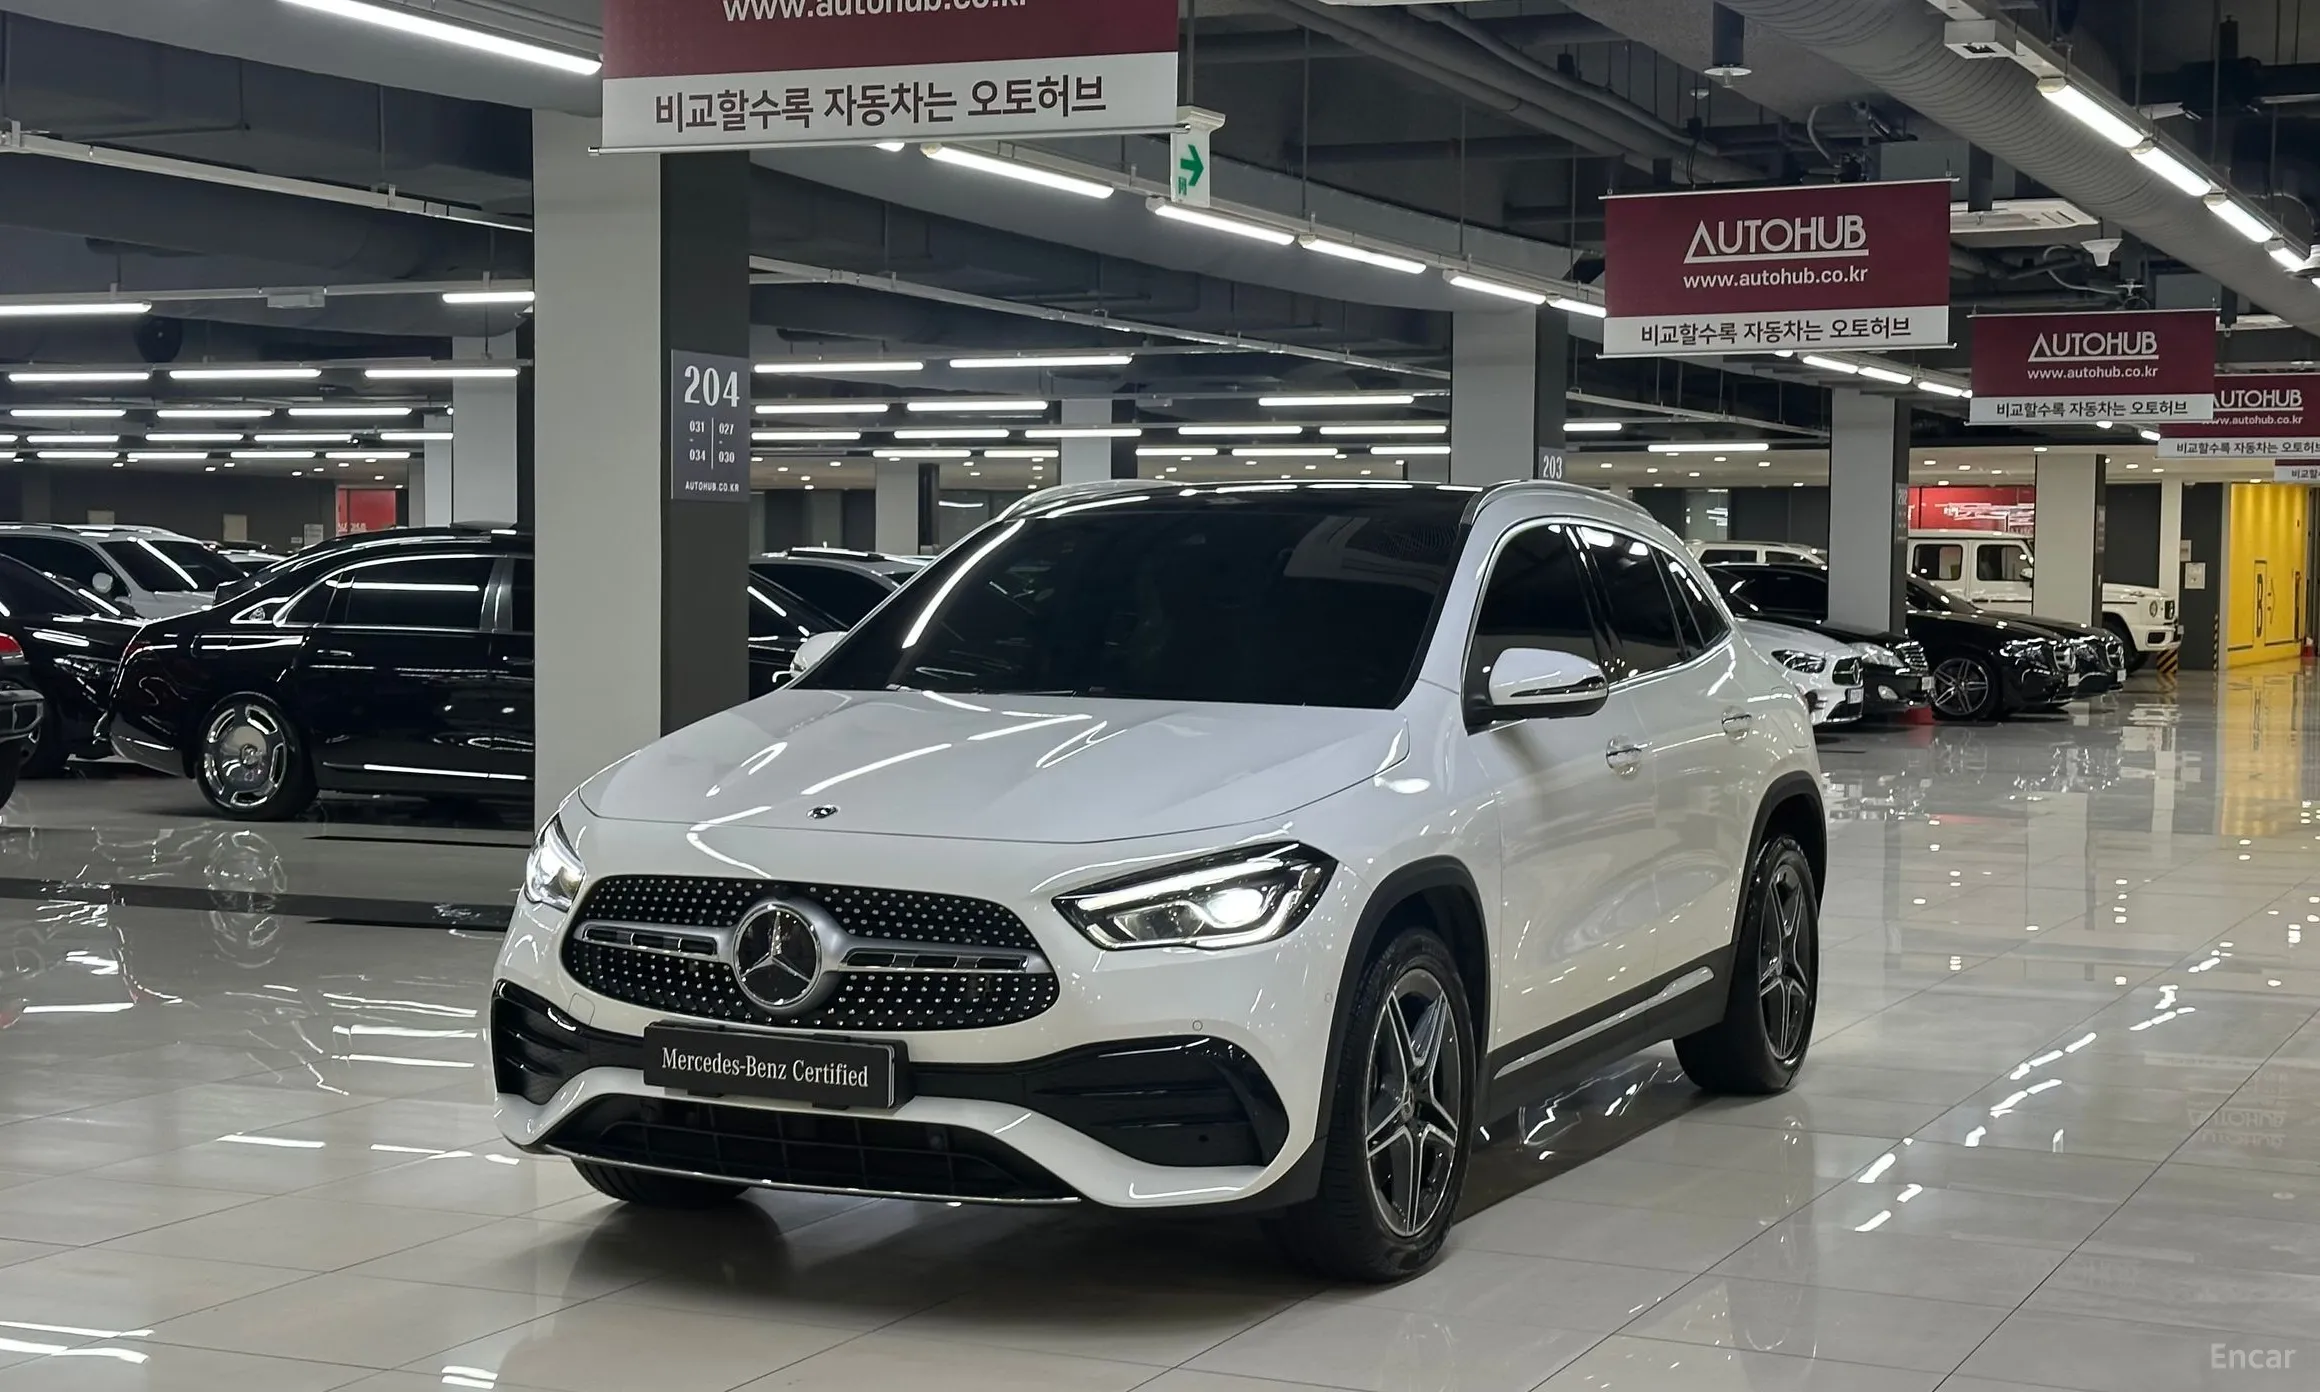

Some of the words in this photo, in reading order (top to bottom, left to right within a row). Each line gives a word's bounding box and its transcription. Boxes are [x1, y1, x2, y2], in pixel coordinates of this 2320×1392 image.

[656, 85, 815, 133] 비교할수록
[824, 81, 958, 127] 자동차는
[967, 74, 1108, 118] 오토허브
[1683, 214, 1870, 264] AUTOHUB
[1683, 265, 1868, 289] www.autohub.co.kr
[1641, 322, 1738, 345] 비교할수록
[1743, 319, 1824, 344] 자동차는
[1829, 316, 1912, 340] 오토허브
[2027, 331, 2160, 363] AUTOHUB
[2027, 365, 2159, 380] www.autohub.co.kr
[684, 365, 740, 408] 204
[1996, 402, 2066, 419] 비교할수록
[2070, 401, 2127, 418] 자동차는
[2130, 400, 2189, 417] 오토허브
[689, 420, 705, 433] 031
[718, 422, 734, 435] 027
[689, 449, 706, 461] 034
[718, 451, 735, 463] 030
[2176, 442, 2231, 455] 비교할수록
[2234, 442, 2278, 455] 자동차는
[1543, 455, 1563, 479] 203
[685, 481, 740, 492] AUTOHUB.CO.KR
[661, 1047, 787, 1080] Mercedes-Benz
[792, 1059, 868, 1087] Certified
